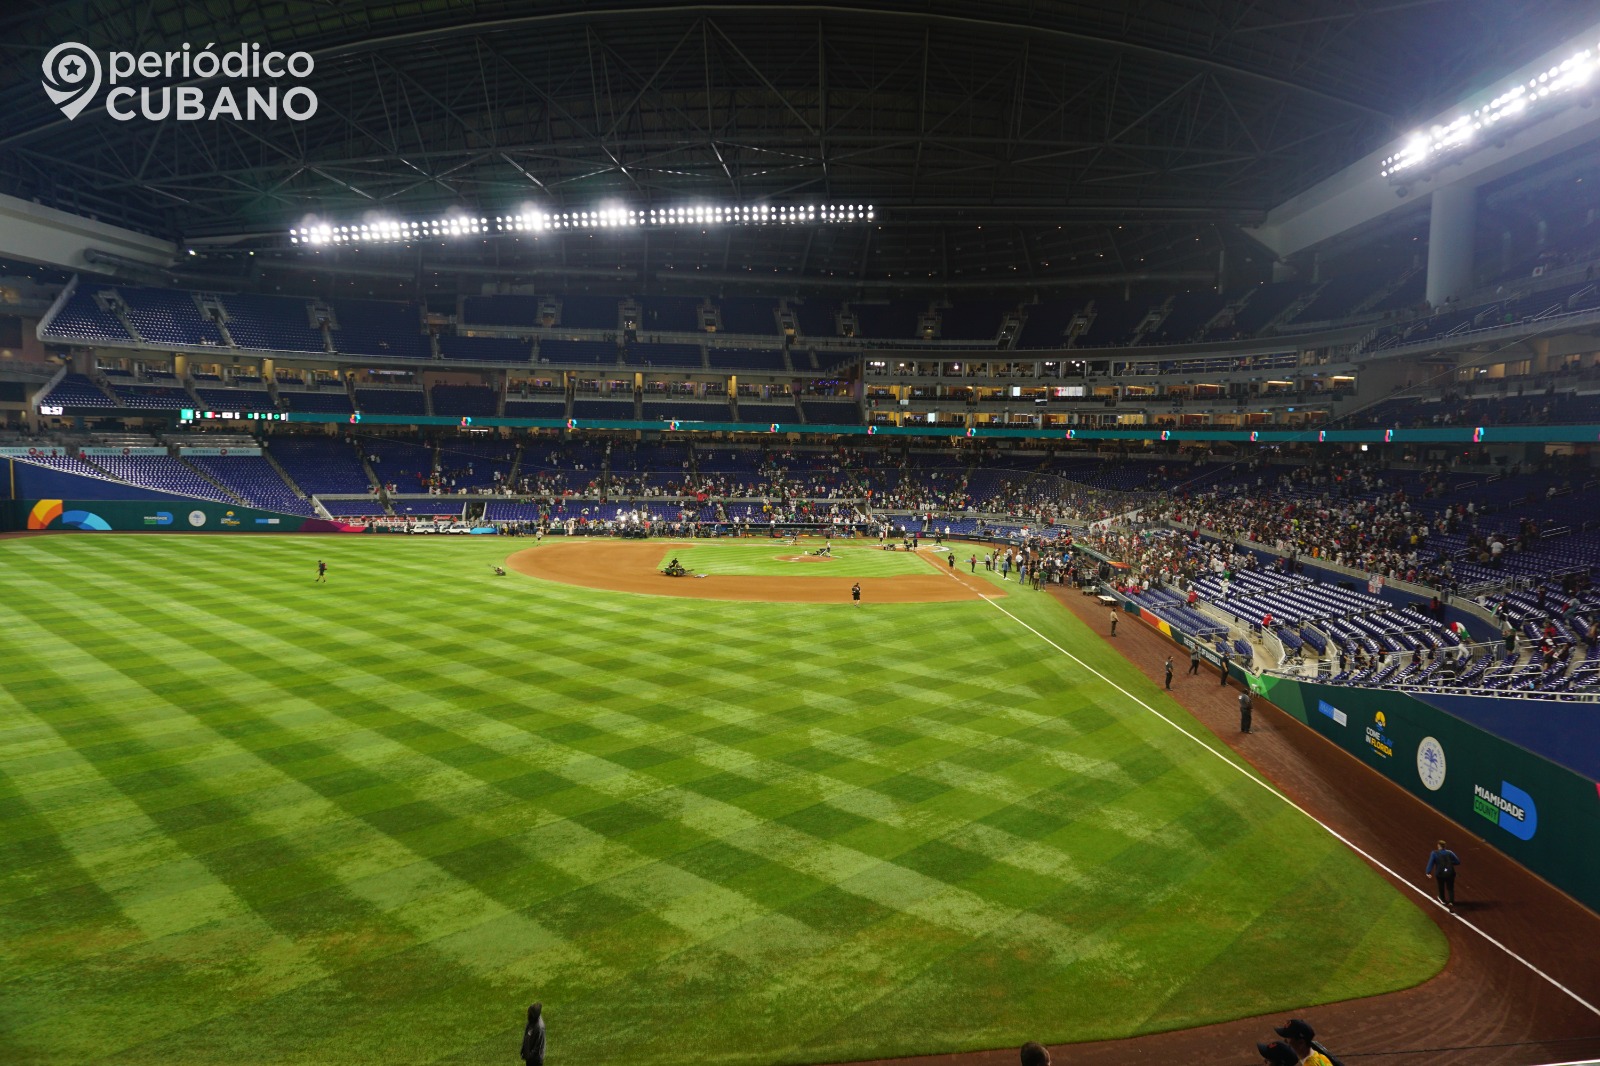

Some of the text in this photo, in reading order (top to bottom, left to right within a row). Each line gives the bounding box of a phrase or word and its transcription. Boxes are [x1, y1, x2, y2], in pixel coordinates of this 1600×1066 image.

[195, 411, 201, 419] 5
[1365, 734, 1371, 744] IN
[1371, 737, 1393, 757] FLORIDA
[1366, 726, 1393, 747] COME PLAY
[1474, 784, 1525, 821] MIAMI-DADE
[1474, 799, 1497, 820] COUNTY
